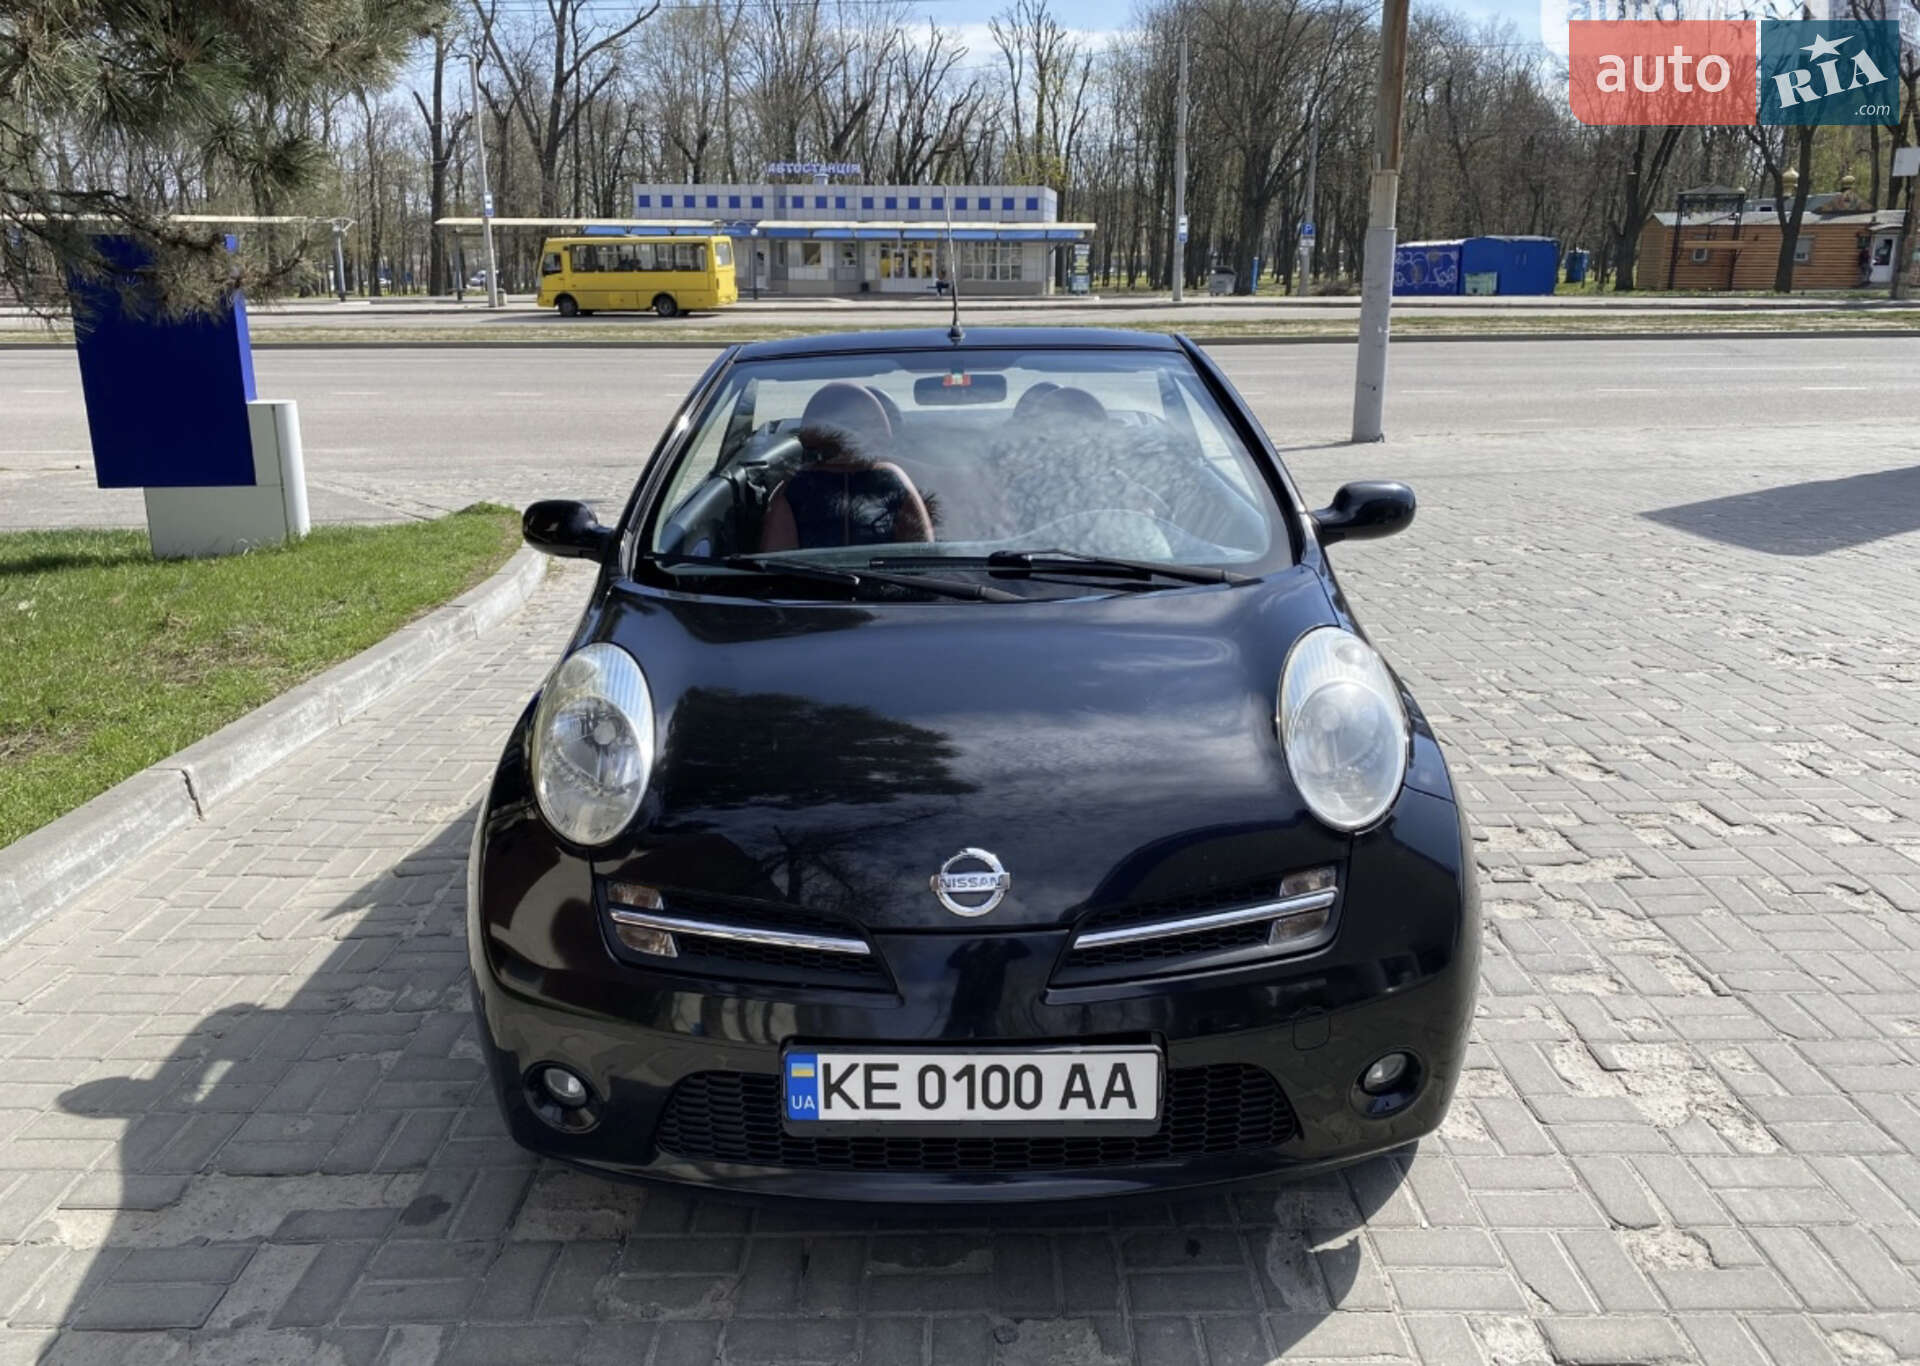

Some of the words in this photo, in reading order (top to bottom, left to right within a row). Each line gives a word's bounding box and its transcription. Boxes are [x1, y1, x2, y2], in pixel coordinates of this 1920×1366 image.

[766, 162, 861, 175] АВТОСТАНЦІЯ
[940, 876, 1001, 888] NISSAN
[822, 1062, 901, 1110] KE
[917, 1064, 1043, 1110] 0100
[1059, 1062, 1137, 1110] AA
[791, 1095, 815, 1110] UA
